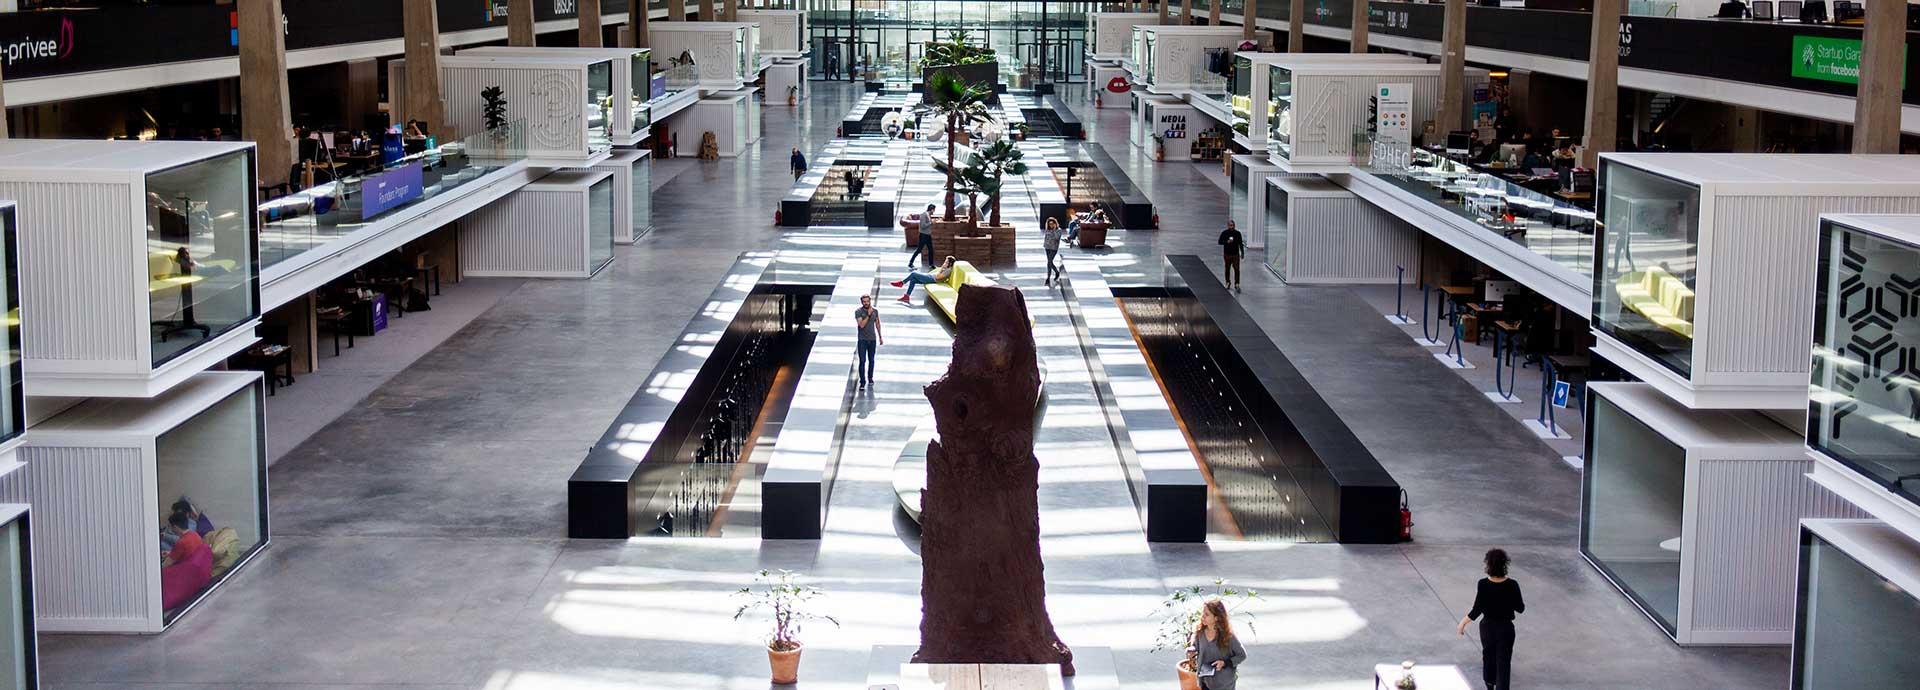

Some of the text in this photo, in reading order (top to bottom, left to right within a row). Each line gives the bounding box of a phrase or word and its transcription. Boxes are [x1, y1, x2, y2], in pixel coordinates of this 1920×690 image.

[0, 36, 57, 65] -privee
[1817, 44, 1843, 62] Startup
[1831, 62, 1860, 77] facebook
[1161, 115, 1186, 123] MEDIA
[1373, 140, 1409, 170] EDHEC
